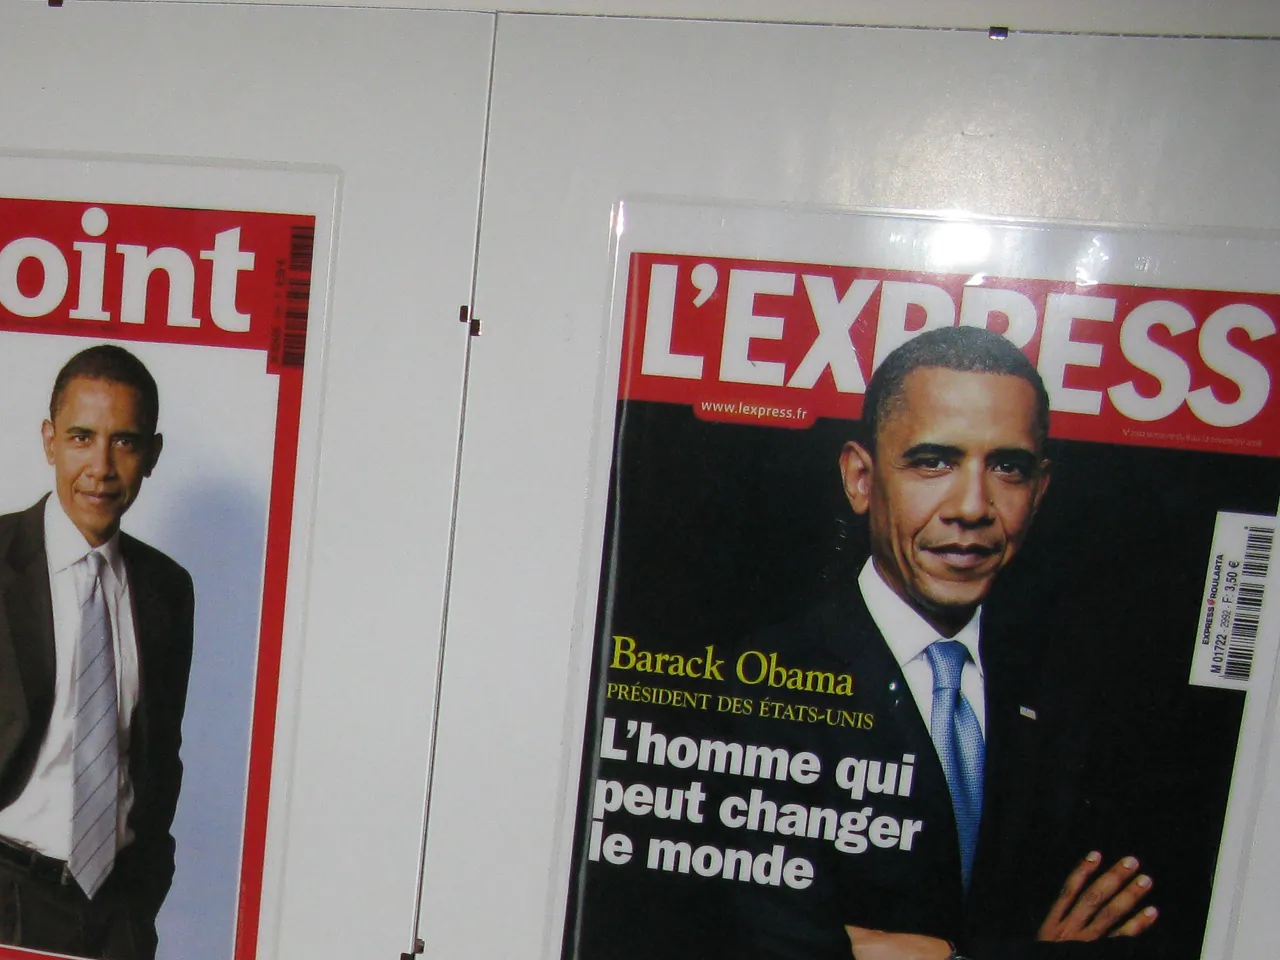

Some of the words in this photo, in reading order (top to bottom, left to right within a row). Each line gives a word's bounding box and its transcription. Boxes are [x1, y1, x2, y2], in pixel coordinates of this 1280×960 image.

[700, 401, 807, 421] www.lexpress.fr
[1225, 571, 1238, 592] 3,50
[1228, 560, 1240, 570] €
[1202, 607, 1215, 645] EXPRESS
[1210, 554, 1224, 599] ROULARTA
[609, 635, 725, 681] Barack
[736, 651, 854, 696] Obama
[1210, 664, 1222, 675] M
[1213, 634, 1227, 663] 01722
[606, 681, 712, 711] PRÉSIDENT
[717, 695, 753, 716] DES
[758, 696, 875, 731] ÉTATS-UNIS
[599, 717, 821, 785] L'homme
[834, 753, 916, 801] qui
[592, 778, 707, 824] peut
[718, 788, 923, 855] changer
[588, 820, 634, 866] le
[646, 837, 815, 891] monde
